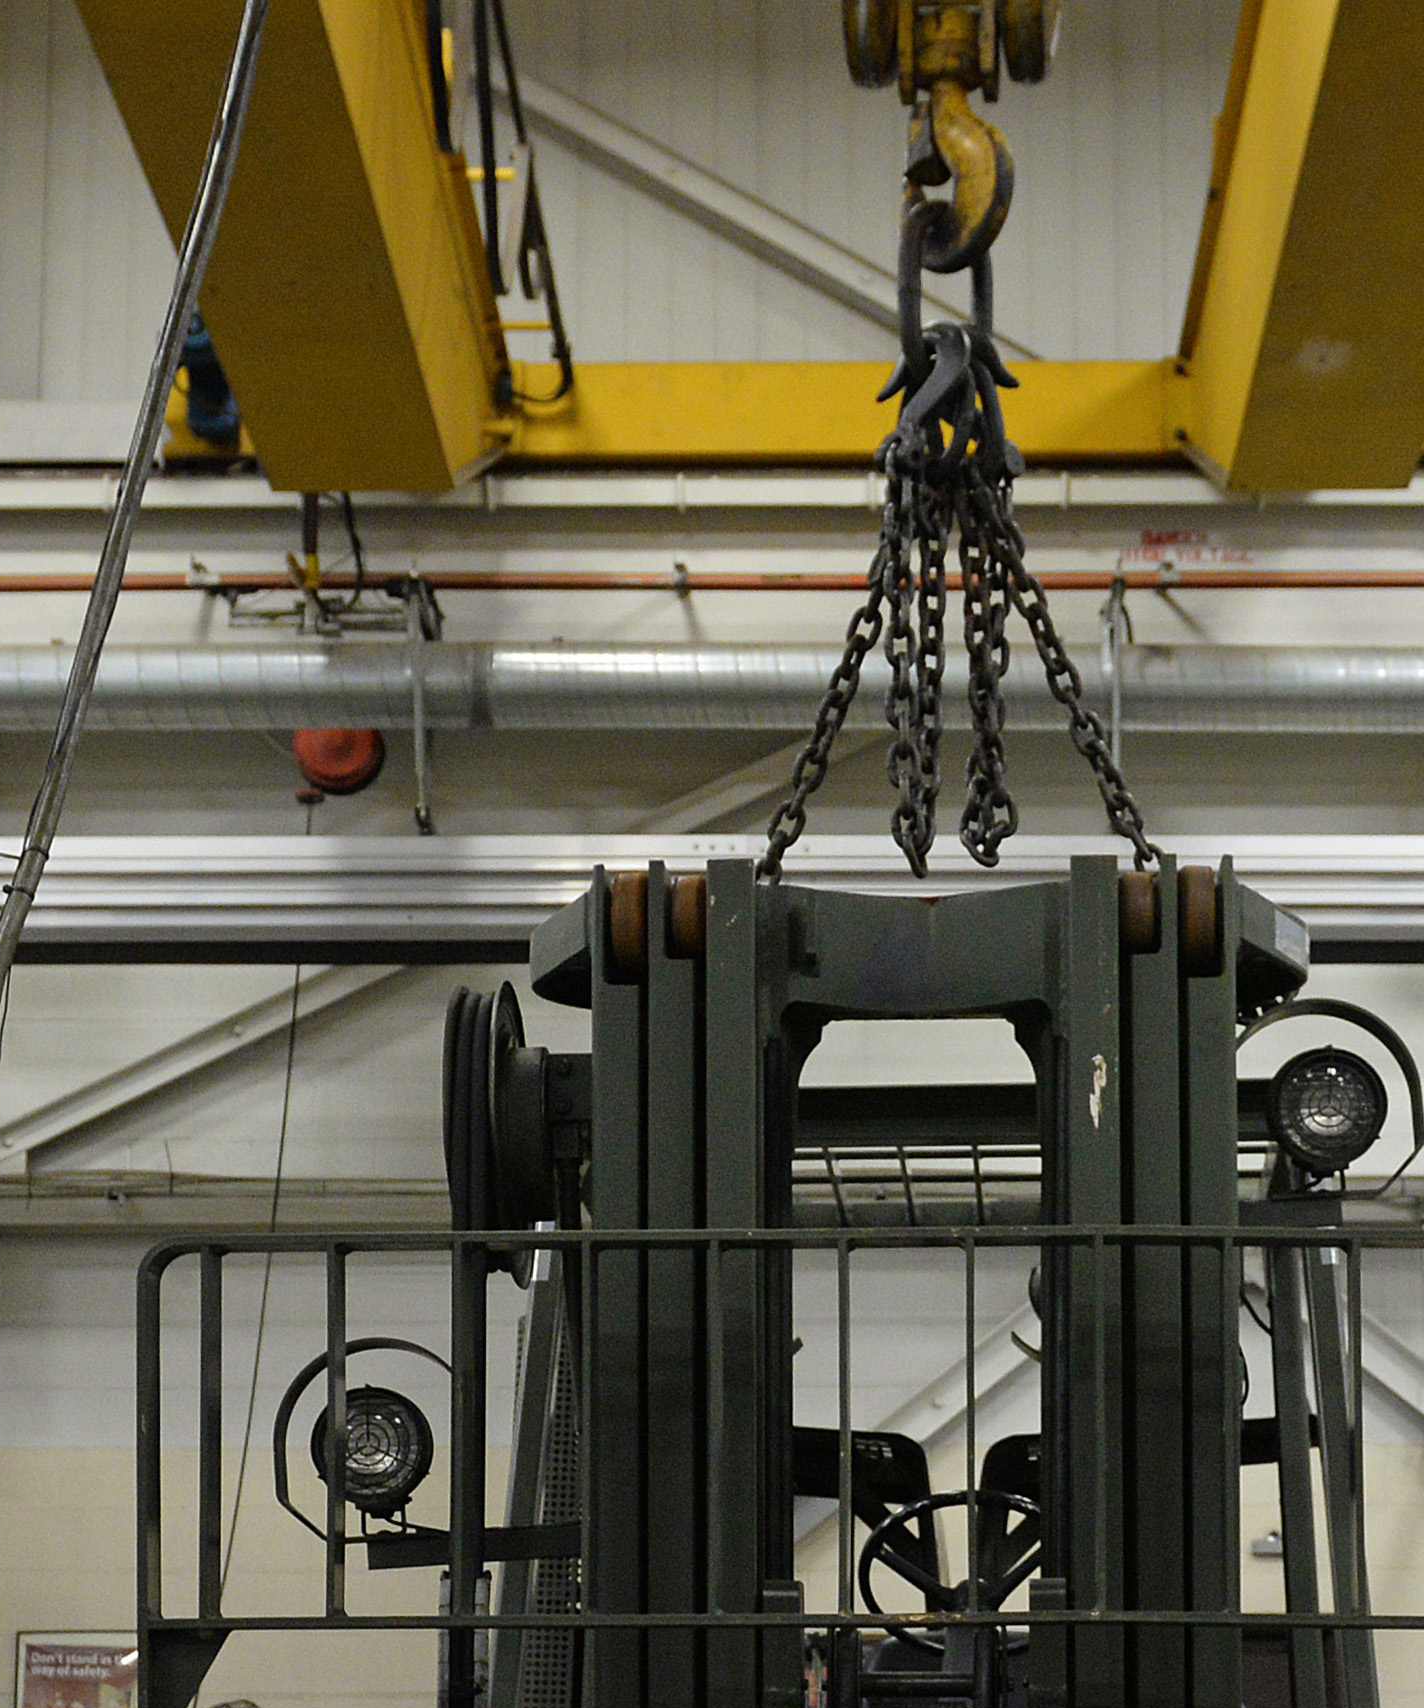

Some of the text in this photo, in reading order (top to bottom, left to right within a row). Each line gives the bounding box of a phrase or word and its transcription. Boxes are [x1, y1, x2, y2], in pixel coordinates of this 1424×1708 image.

[31, 1651, 65, 1664] Don't
[66, 1653, 98, 1665] stand
[100, 1653, 112, 1665] in
[31, 1667, 55, 1677] way
[57, 1665, 71, 1676] of
